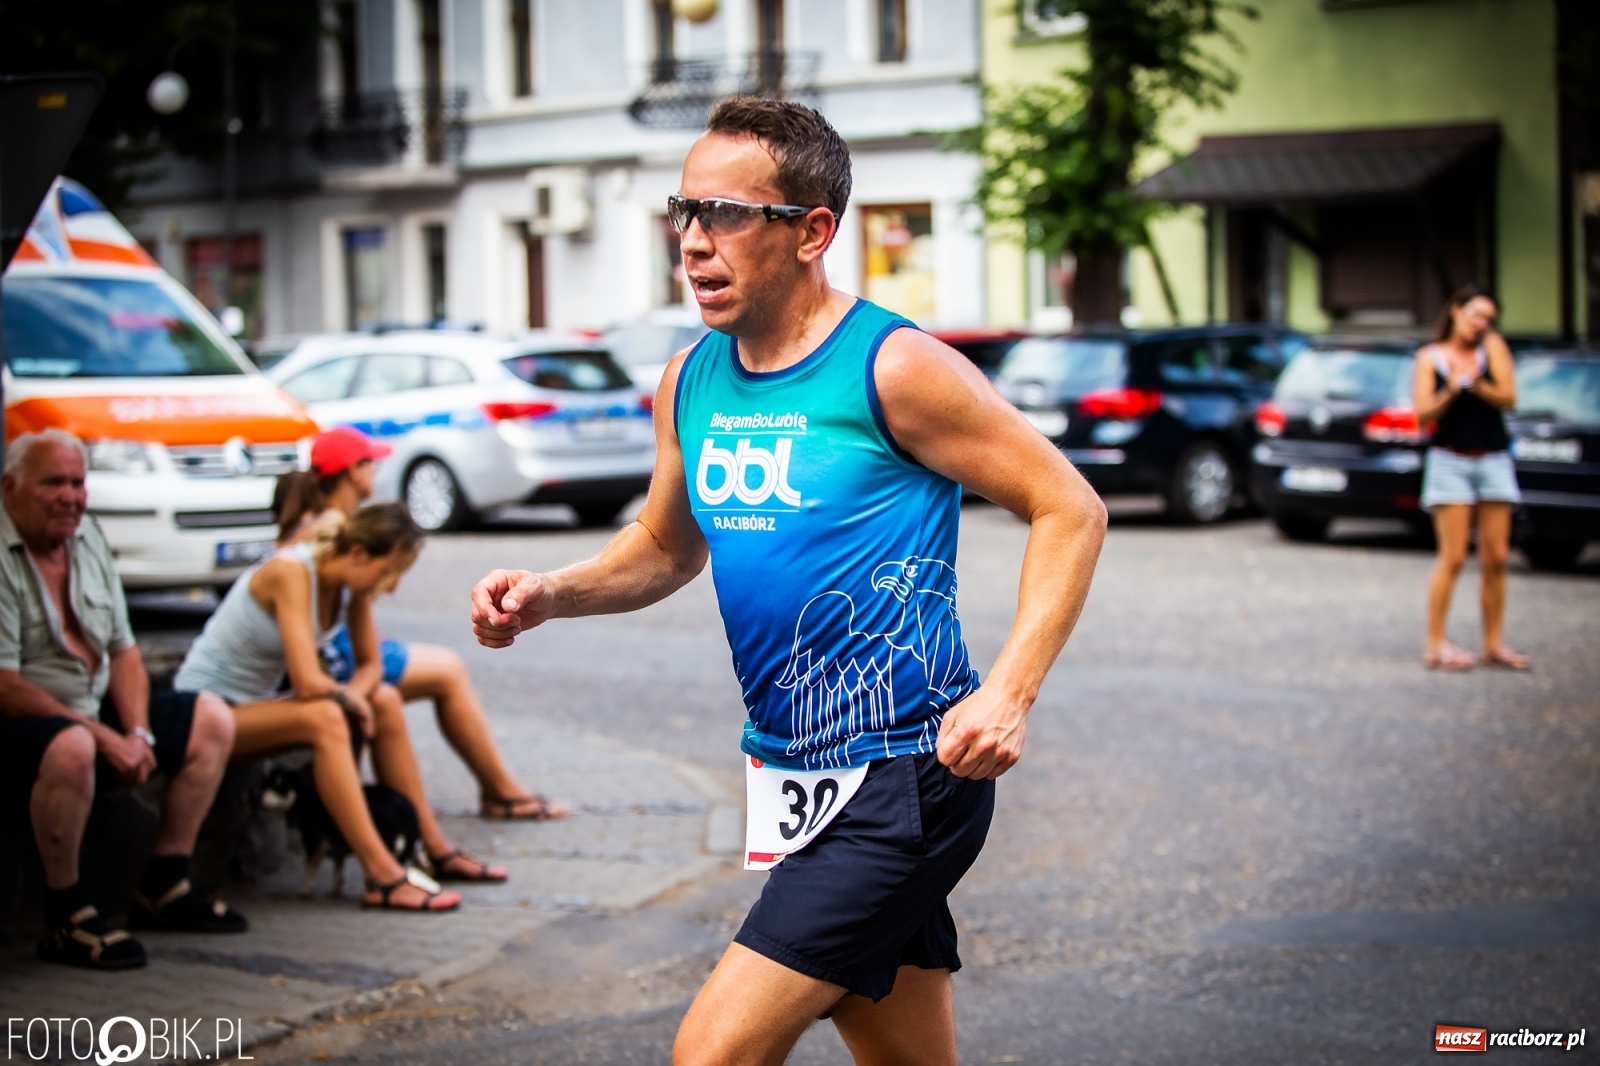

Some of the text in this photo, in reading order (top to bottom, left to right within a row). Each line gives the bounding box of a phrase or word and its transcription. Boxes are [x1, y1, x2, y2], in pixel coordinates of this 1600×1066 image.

[696, 438, 801, 507] bbl
[713, 514, 776, 531] RACIBÓRZ
[779, 778, 839, 840] 30
